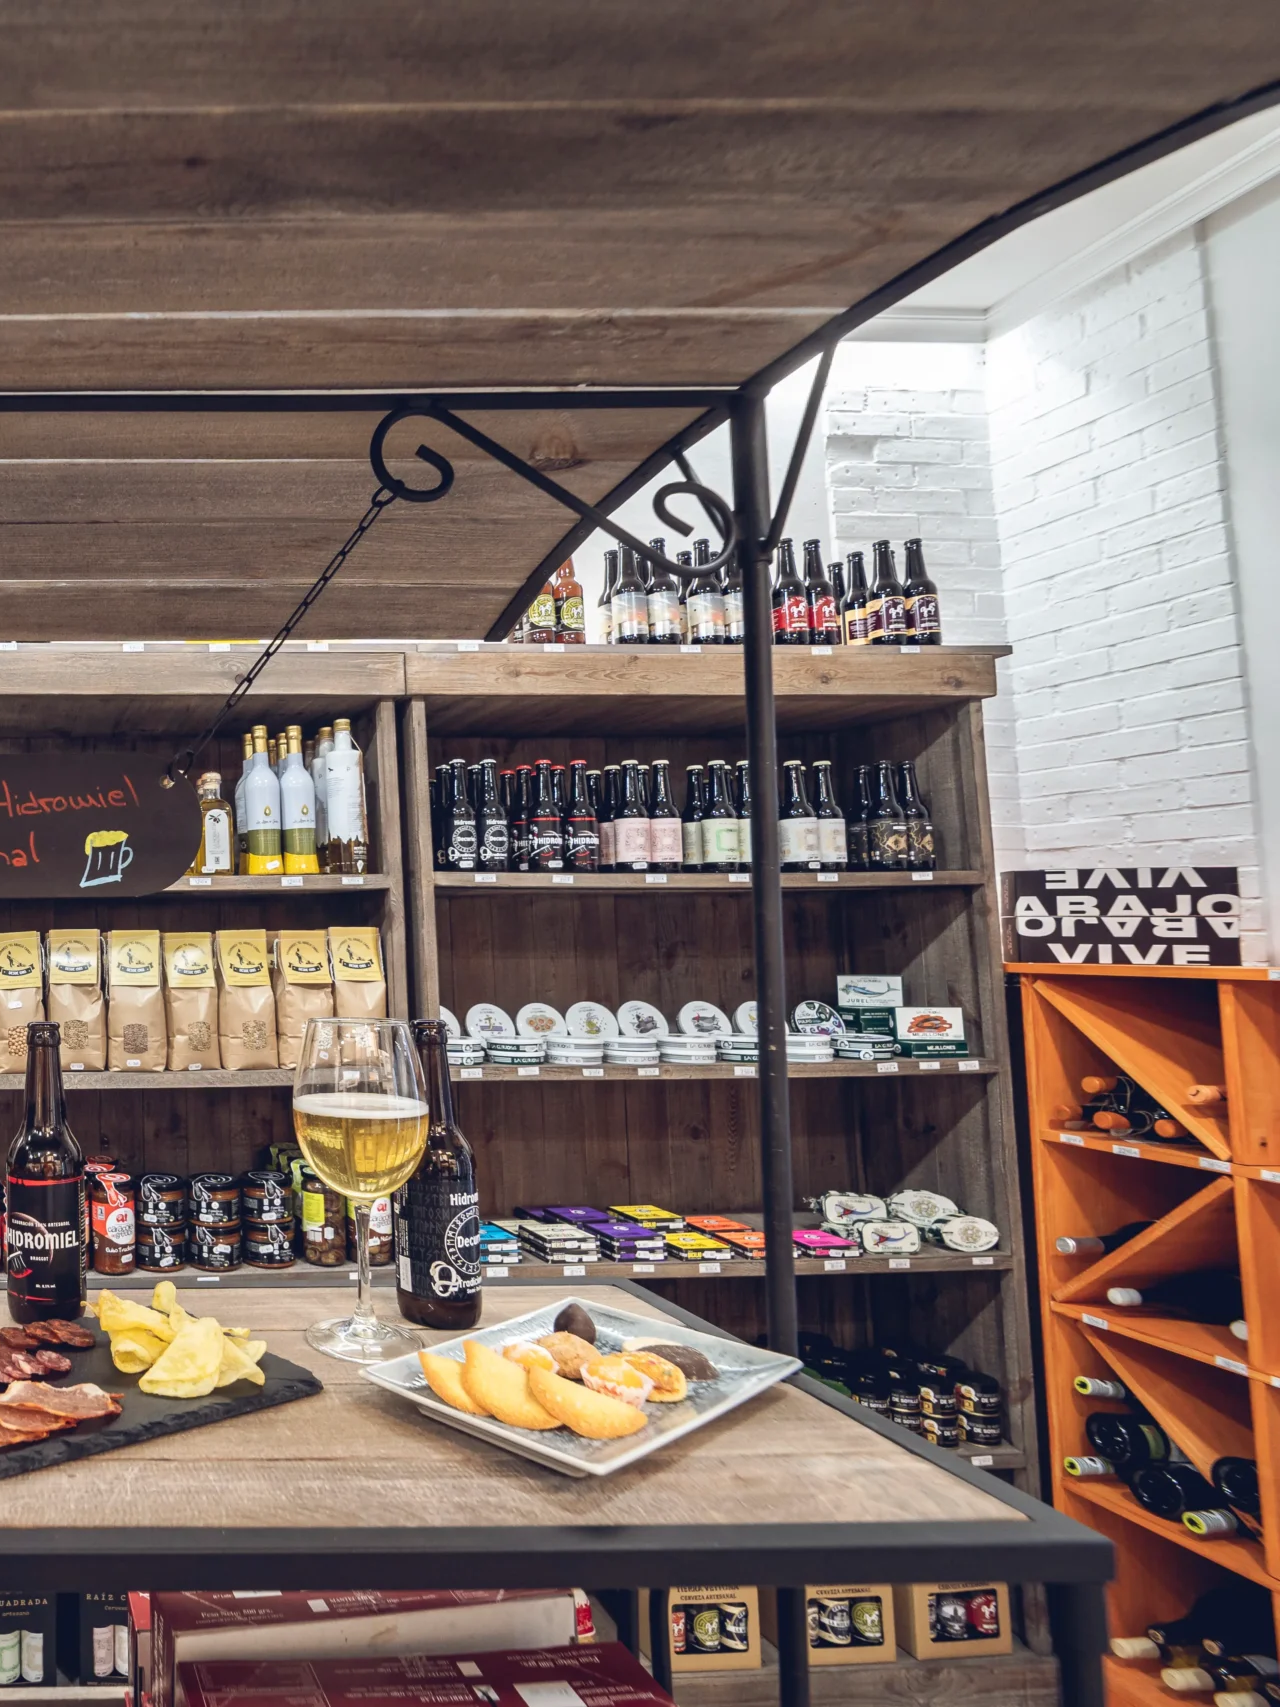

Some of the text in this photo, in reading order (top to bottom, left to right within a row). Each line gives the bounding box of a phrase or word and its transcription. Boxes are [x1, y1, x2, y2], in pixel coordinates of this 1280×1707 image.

[1046, 943, 1211, 967] VIVE
[7, 1227, 80, 1250] HIDROMIEL
[85, 1593, 115, 1601] RAÍZ
